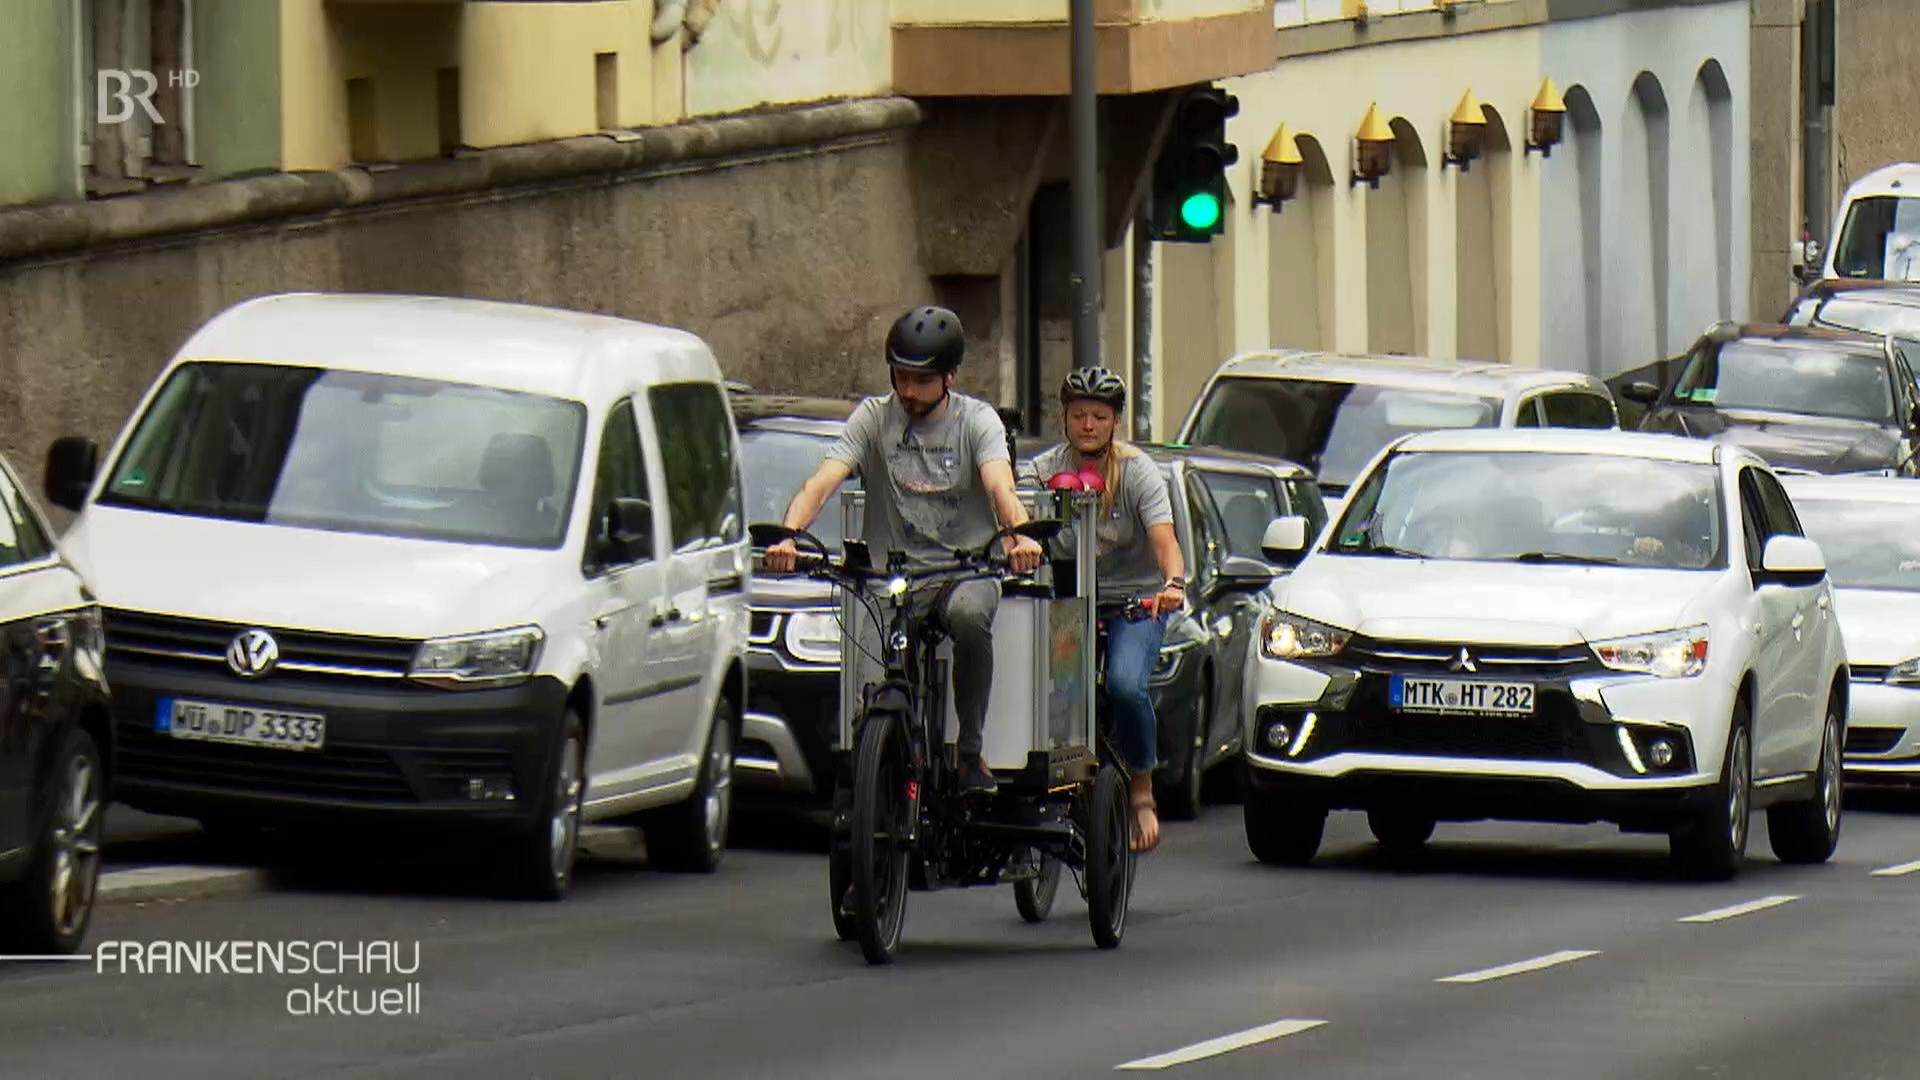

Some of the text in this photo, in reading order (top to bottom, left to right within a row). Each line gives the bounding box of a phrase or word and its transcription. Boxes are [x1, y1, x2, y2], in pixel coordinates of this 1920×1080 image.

[1404, 682, 1532, 709] MTK HT 282
[223, 708, 255, 735] DP
[258, 712, 322, 743] 3333
